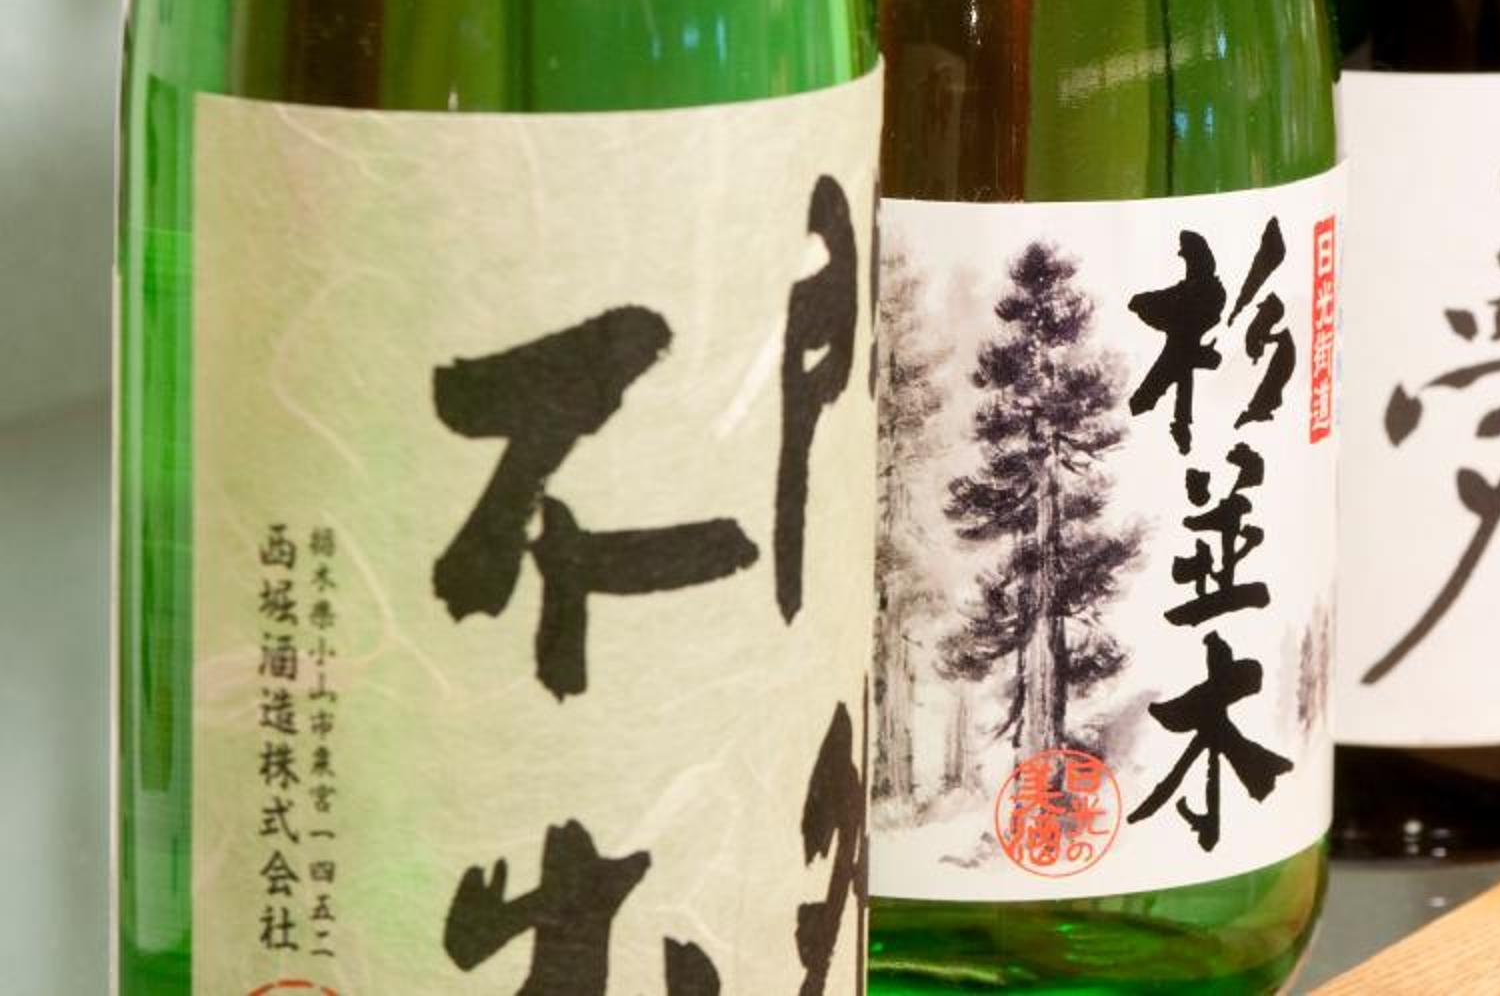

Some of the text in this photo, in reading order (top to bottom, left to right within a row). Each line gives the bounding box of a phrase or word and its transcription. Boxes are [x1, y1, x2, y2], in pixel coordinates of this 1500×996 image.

[258, 522, 301, 953] 西堀酒造株式会社
[1127, 215, 1297, 852] 杉並木
